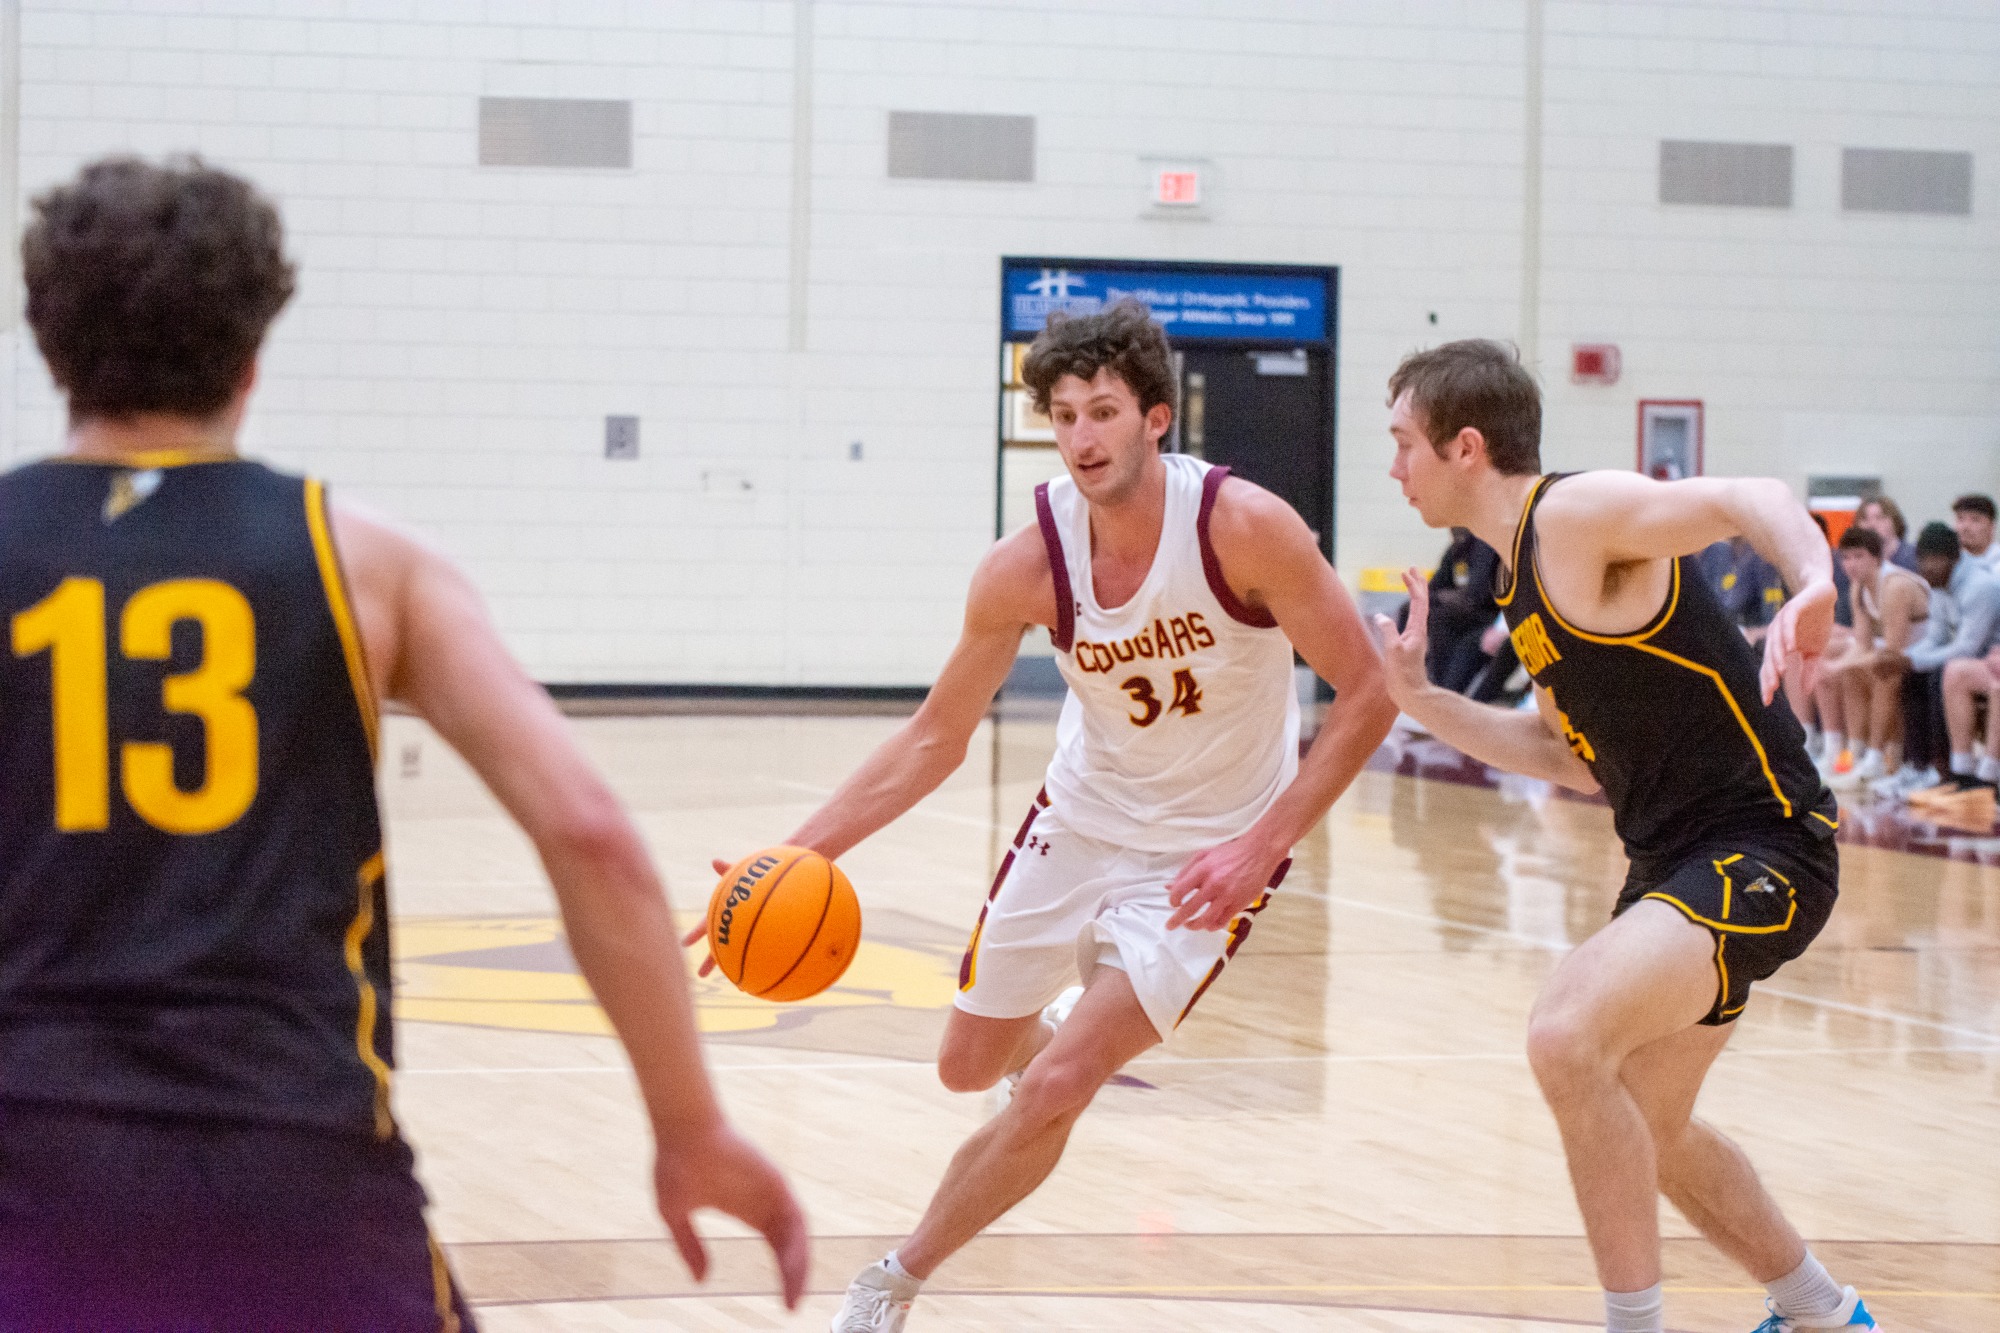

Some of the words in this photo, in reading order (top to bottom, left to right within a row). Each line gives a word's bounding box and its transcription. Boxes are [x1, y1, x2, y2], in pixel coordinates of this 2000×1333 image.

[1076, 612, 1216, 674] COUGARS
[11, 575, 260, 834] 13
[1120, 666, 1203, 728] 34
[717, 855, 781, 946] Wilson
